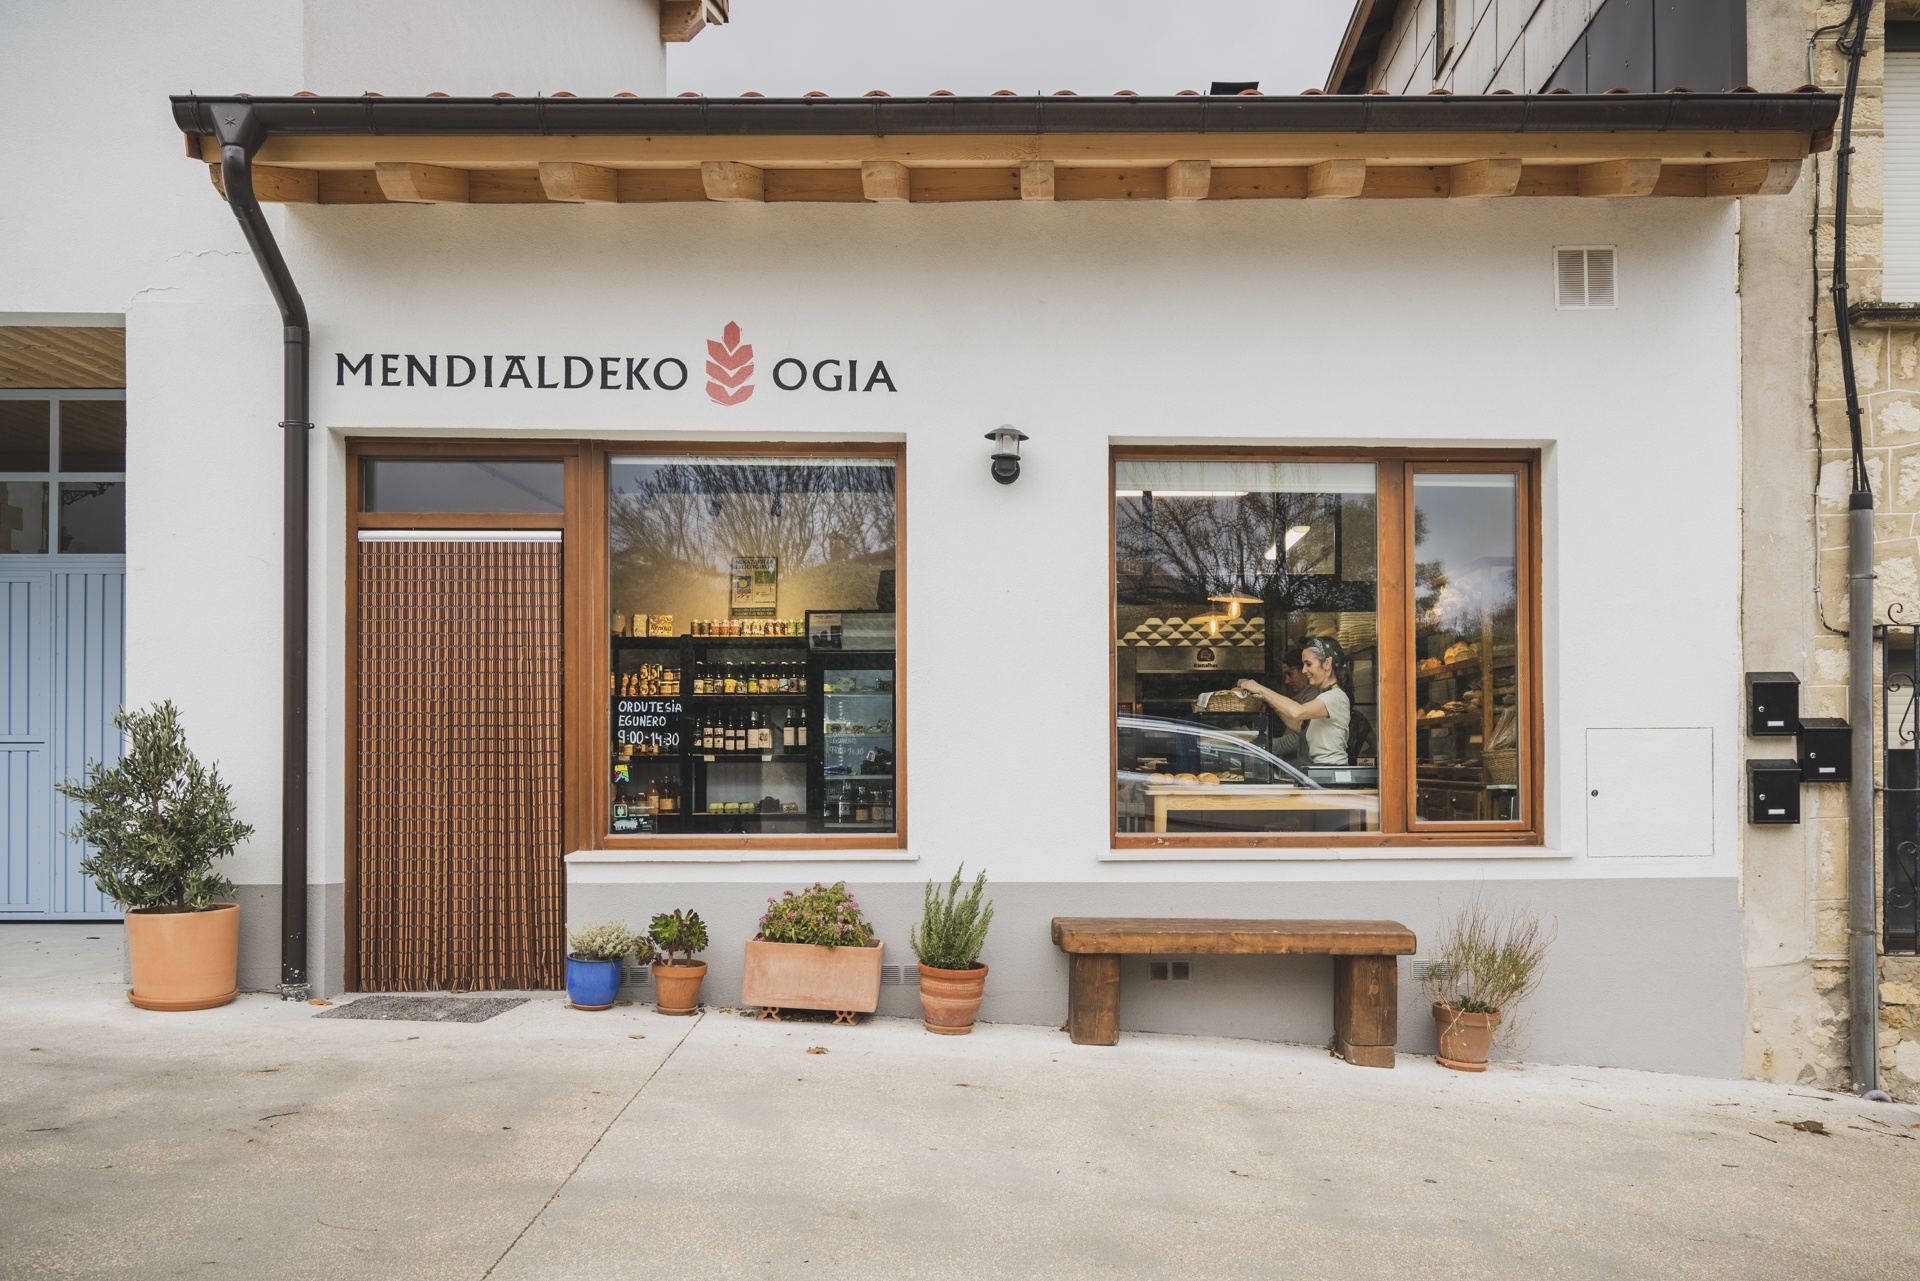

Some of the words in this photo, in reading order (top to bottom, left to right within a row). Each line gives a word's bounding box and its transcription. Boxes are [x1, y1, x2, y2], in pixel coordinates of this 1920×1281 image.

[336, 353, 688, 390] MENDIALDEKO
[772, 358, 898, 392] OGIA
[618, 715, 667, 727] EGUNERO
